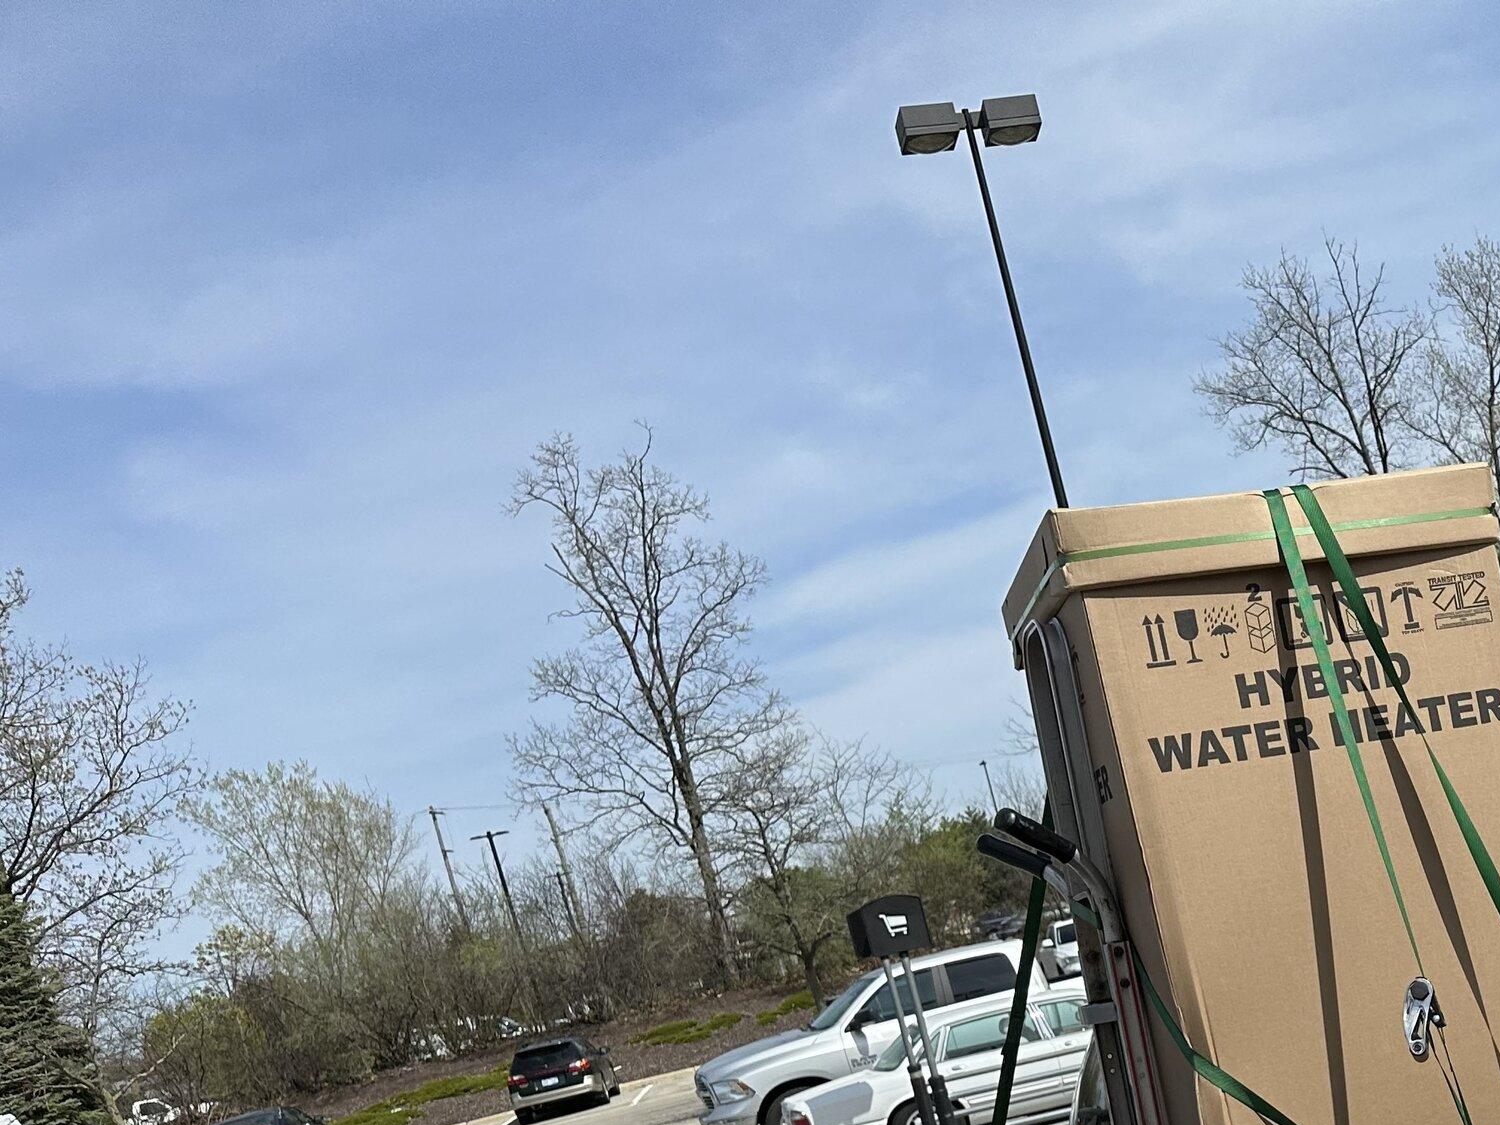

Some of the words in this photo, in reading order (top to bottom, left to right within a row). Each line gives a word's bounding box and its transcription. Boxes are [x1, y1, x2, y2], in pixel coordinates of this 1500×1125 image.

[1245, 583, 1262, 602] 2
[1427, 575, 1457, 586] TRANSIT
[1457, 571, 1486, 581] TESTED
[1234, 652, 1411, 709] HYBRID
[1147, 716, 1320, 773] WATER
